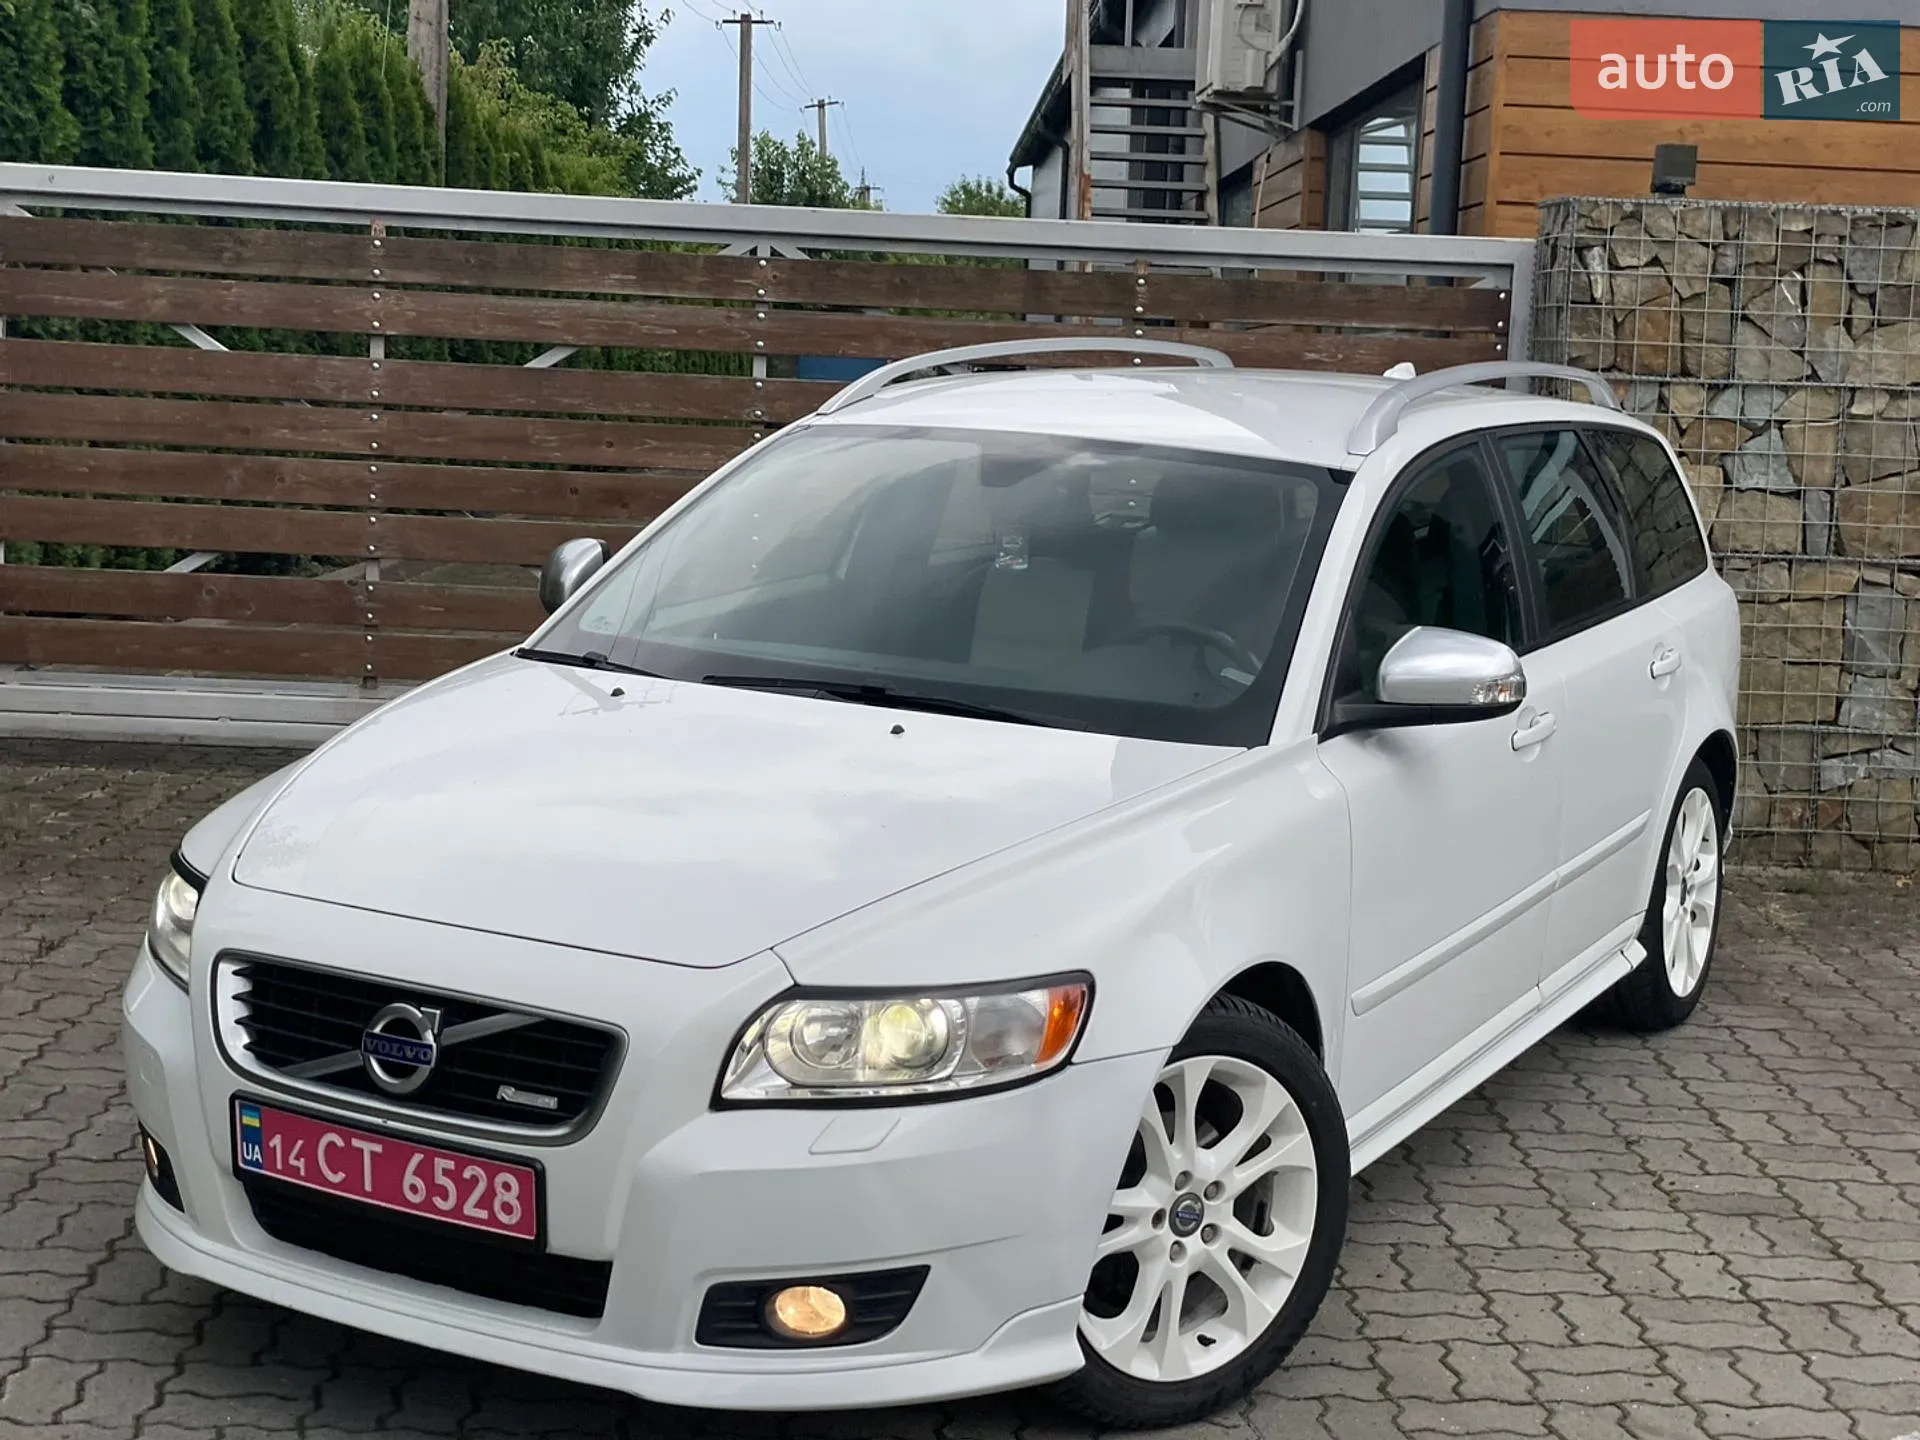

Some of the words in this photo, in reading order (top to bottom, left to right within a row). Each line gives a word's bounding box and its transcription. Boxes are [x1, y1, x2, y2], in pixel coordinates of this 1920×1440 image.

[365, 1038, 433, 1061] VOLVO
[242, 1142, 262, 1164] UA
[268, 1134, 305, 1177] 14
[317, 1132, 383, 1193] CT
[402, 1152, 522, 1225] 6528
